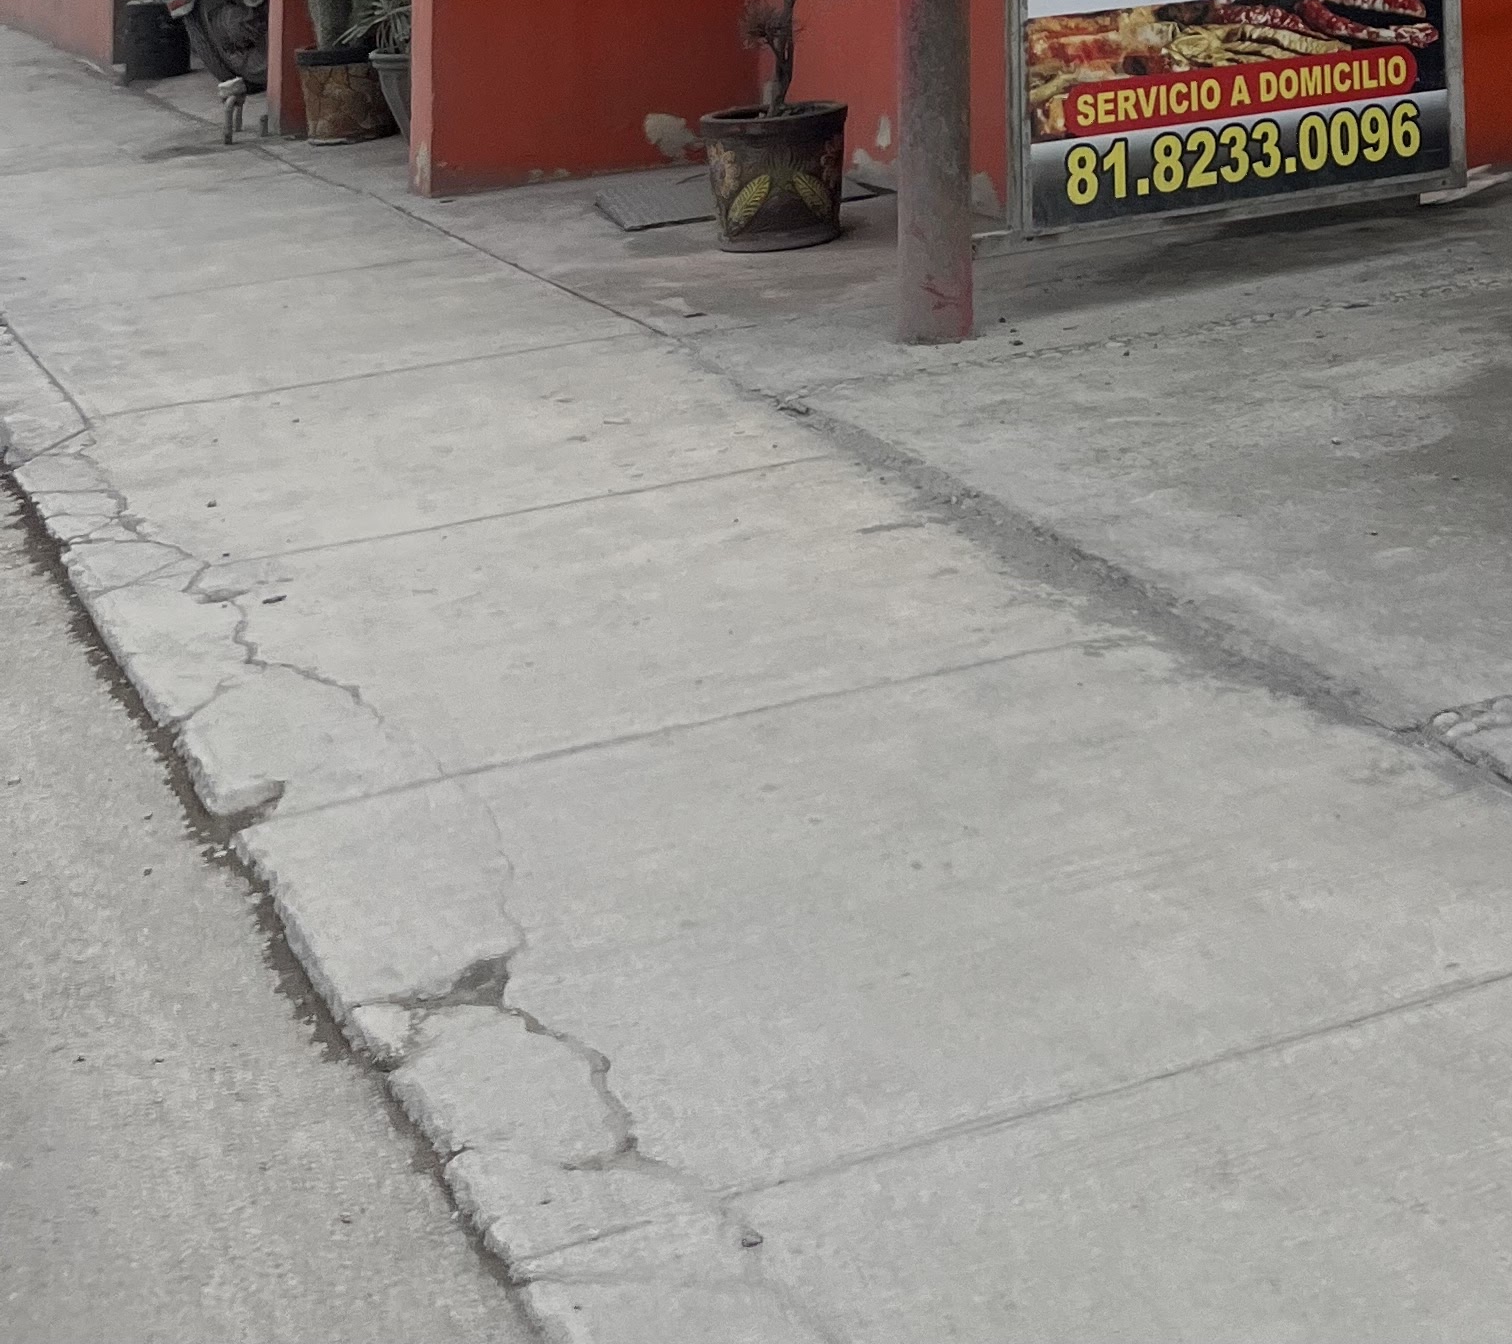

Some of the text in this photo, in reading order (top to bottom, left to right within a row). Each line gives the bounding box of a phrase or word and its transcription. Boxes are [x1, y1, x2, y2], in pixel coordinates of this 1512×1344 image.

[1076, 55, 1409, 127] SERVICIO A DOMICILIO
[1064, 102, 1422, 205] 81.8233.0096
